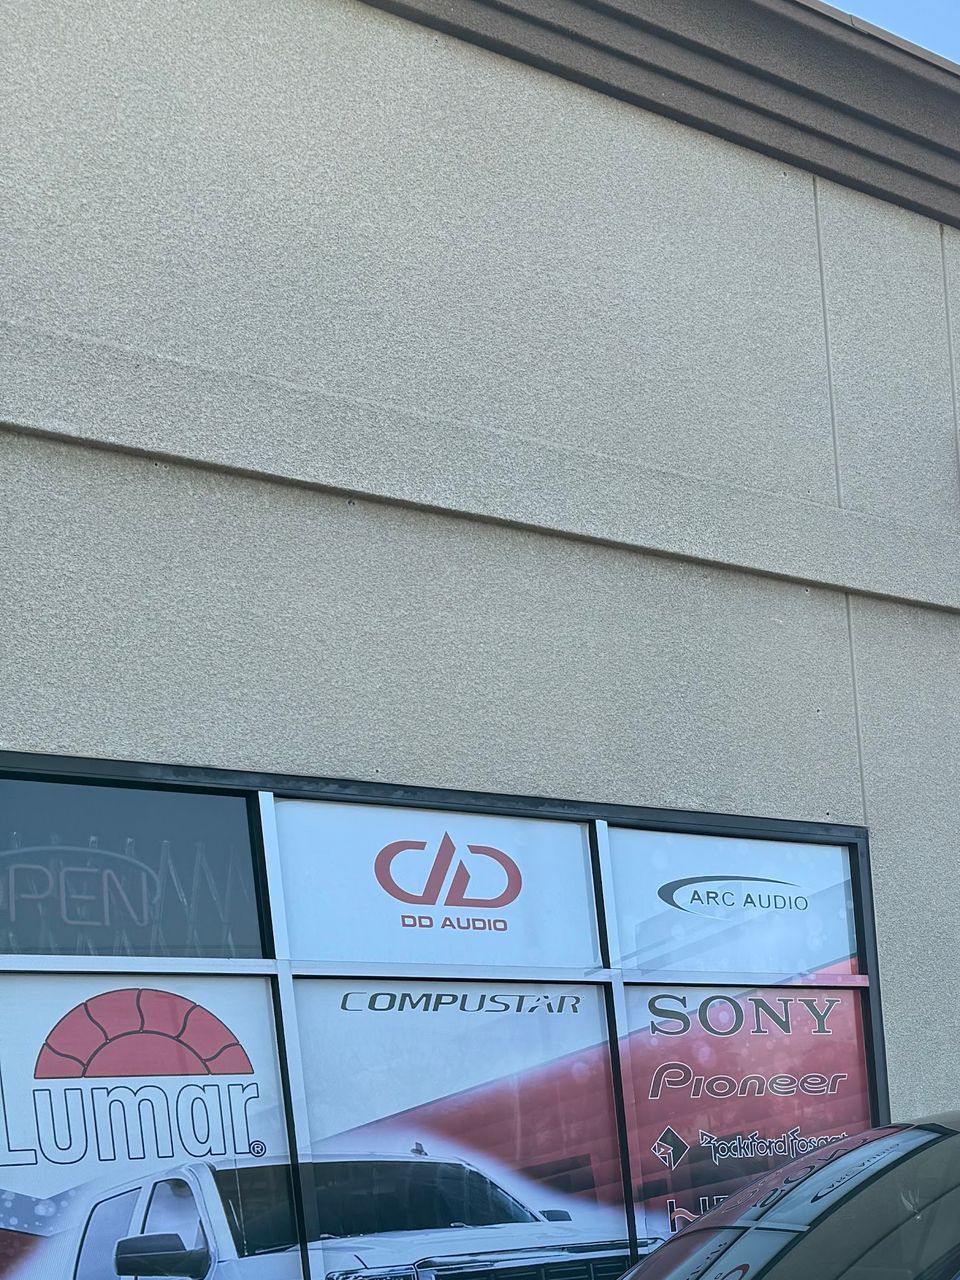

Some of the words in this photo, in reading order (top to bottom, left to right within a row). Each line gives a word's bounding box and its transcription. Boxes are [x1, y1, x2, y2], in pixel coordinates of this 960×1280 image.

[0, 863, 151, 928] PEN
[689, 889, 736, 906] ARC
[742, 892, 809, 911] AUDIO
[401, 914, 433, 928] DD
[441, 917, 508, 932] AUDIO
[340, 991, 583, 1014] COMPUSTAR
[647, 994, 841, 1038] SONY
[648, 1062, 848, 1099] Pioneer
